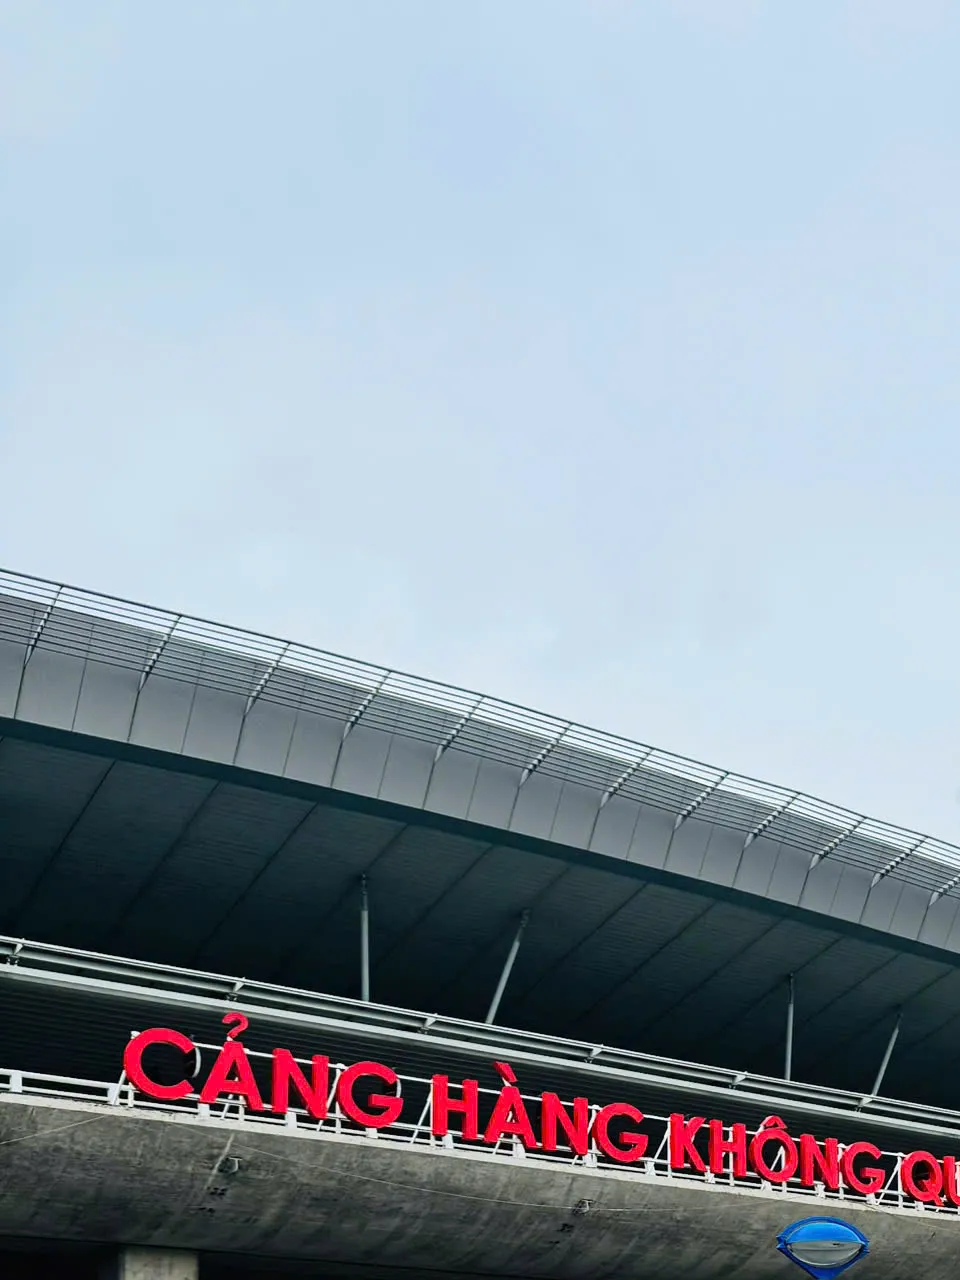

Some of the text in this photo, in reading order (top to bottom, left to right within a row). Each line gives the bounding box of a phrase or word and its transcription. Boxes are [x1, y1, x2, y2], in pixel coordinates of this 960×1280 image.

[122, 1012, 404, 1129] CẢNG
[431, 1063, 649, 1164] HÀNG
[669, 1112, 886, 1196] KHÔNG
